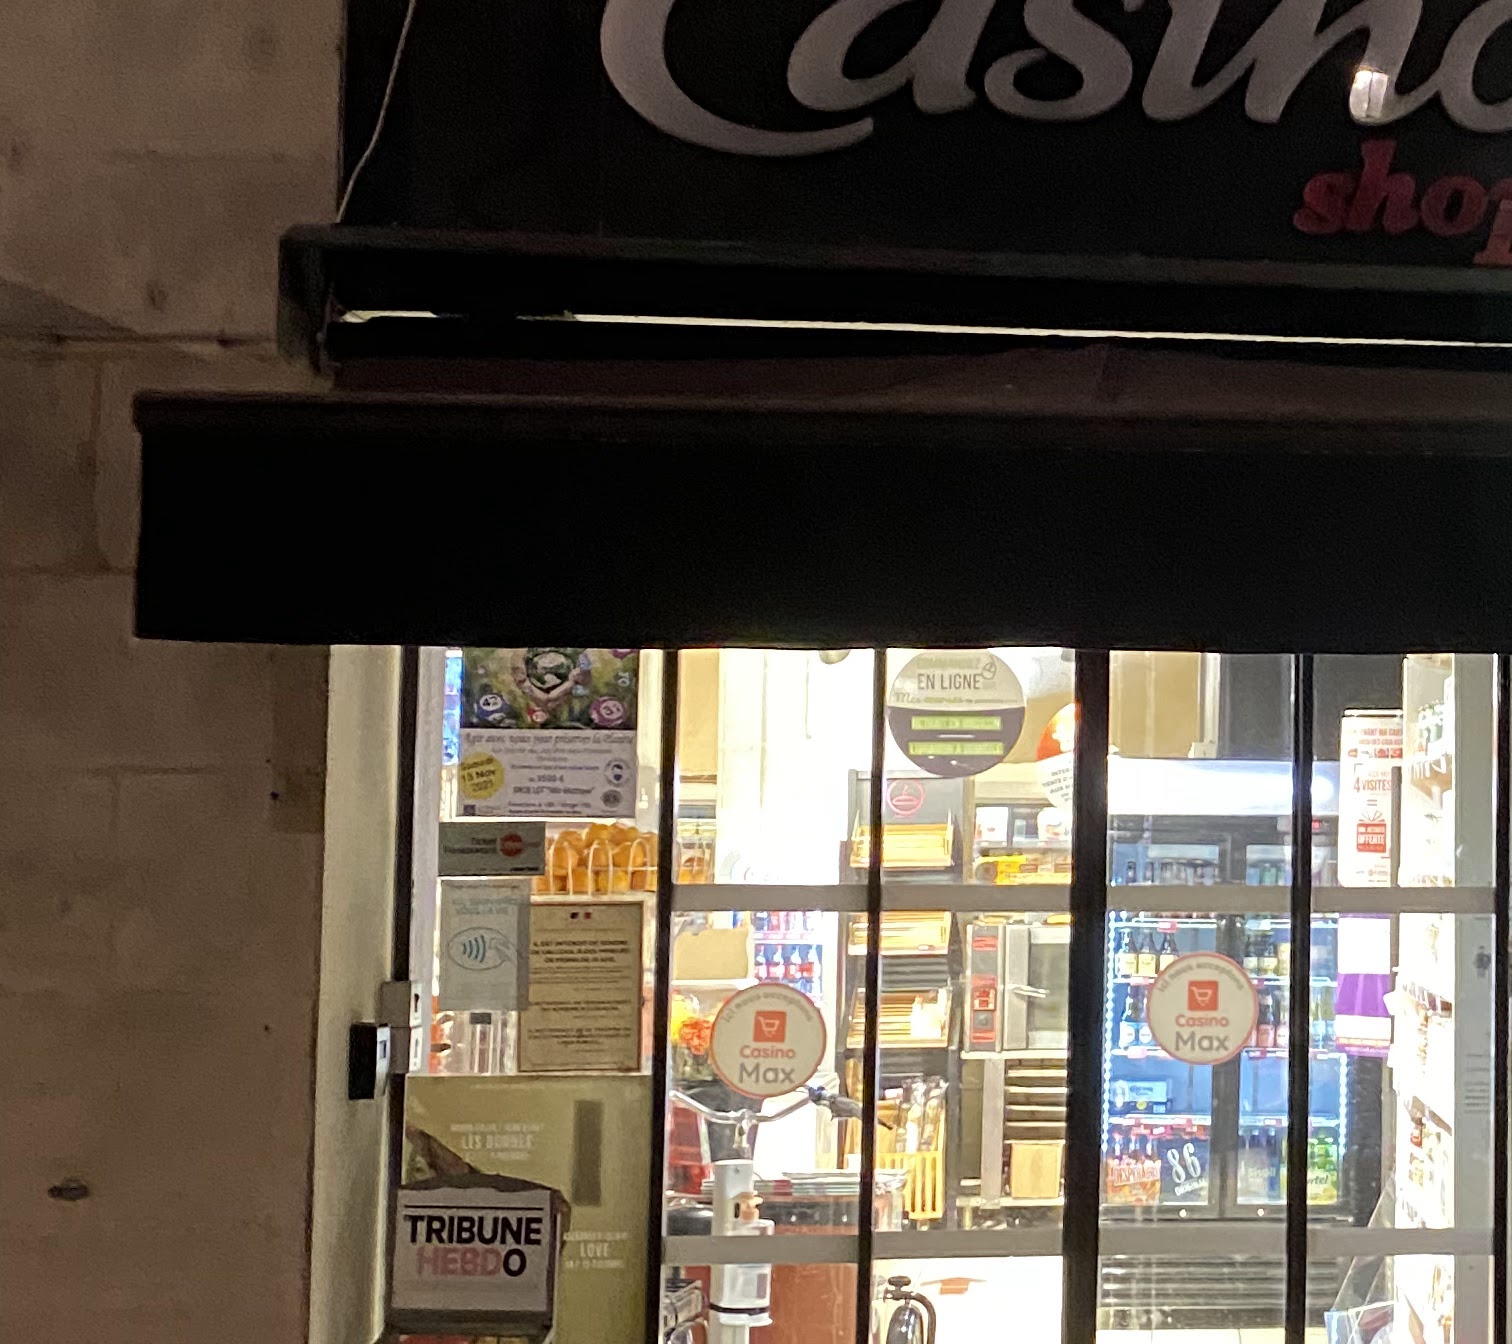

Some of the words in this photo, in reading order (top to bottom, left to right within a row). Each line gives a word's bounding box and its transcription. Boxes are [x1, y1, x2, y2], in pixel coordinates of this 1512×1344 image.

[916, 673, 936, 690] EN
[940, 673, 981, 690] LIGNE
[1174, 1013, 1230, 1028] Casino
[739, 1044, 796, 1059] Casino
[1174, 1030, 1230, 1052] Max
[738, 1061, 795, 1085] Max
[404, 1213, 544, 1246] TRIBUNE
[416, 1246, 527, 1278] HEBDO
